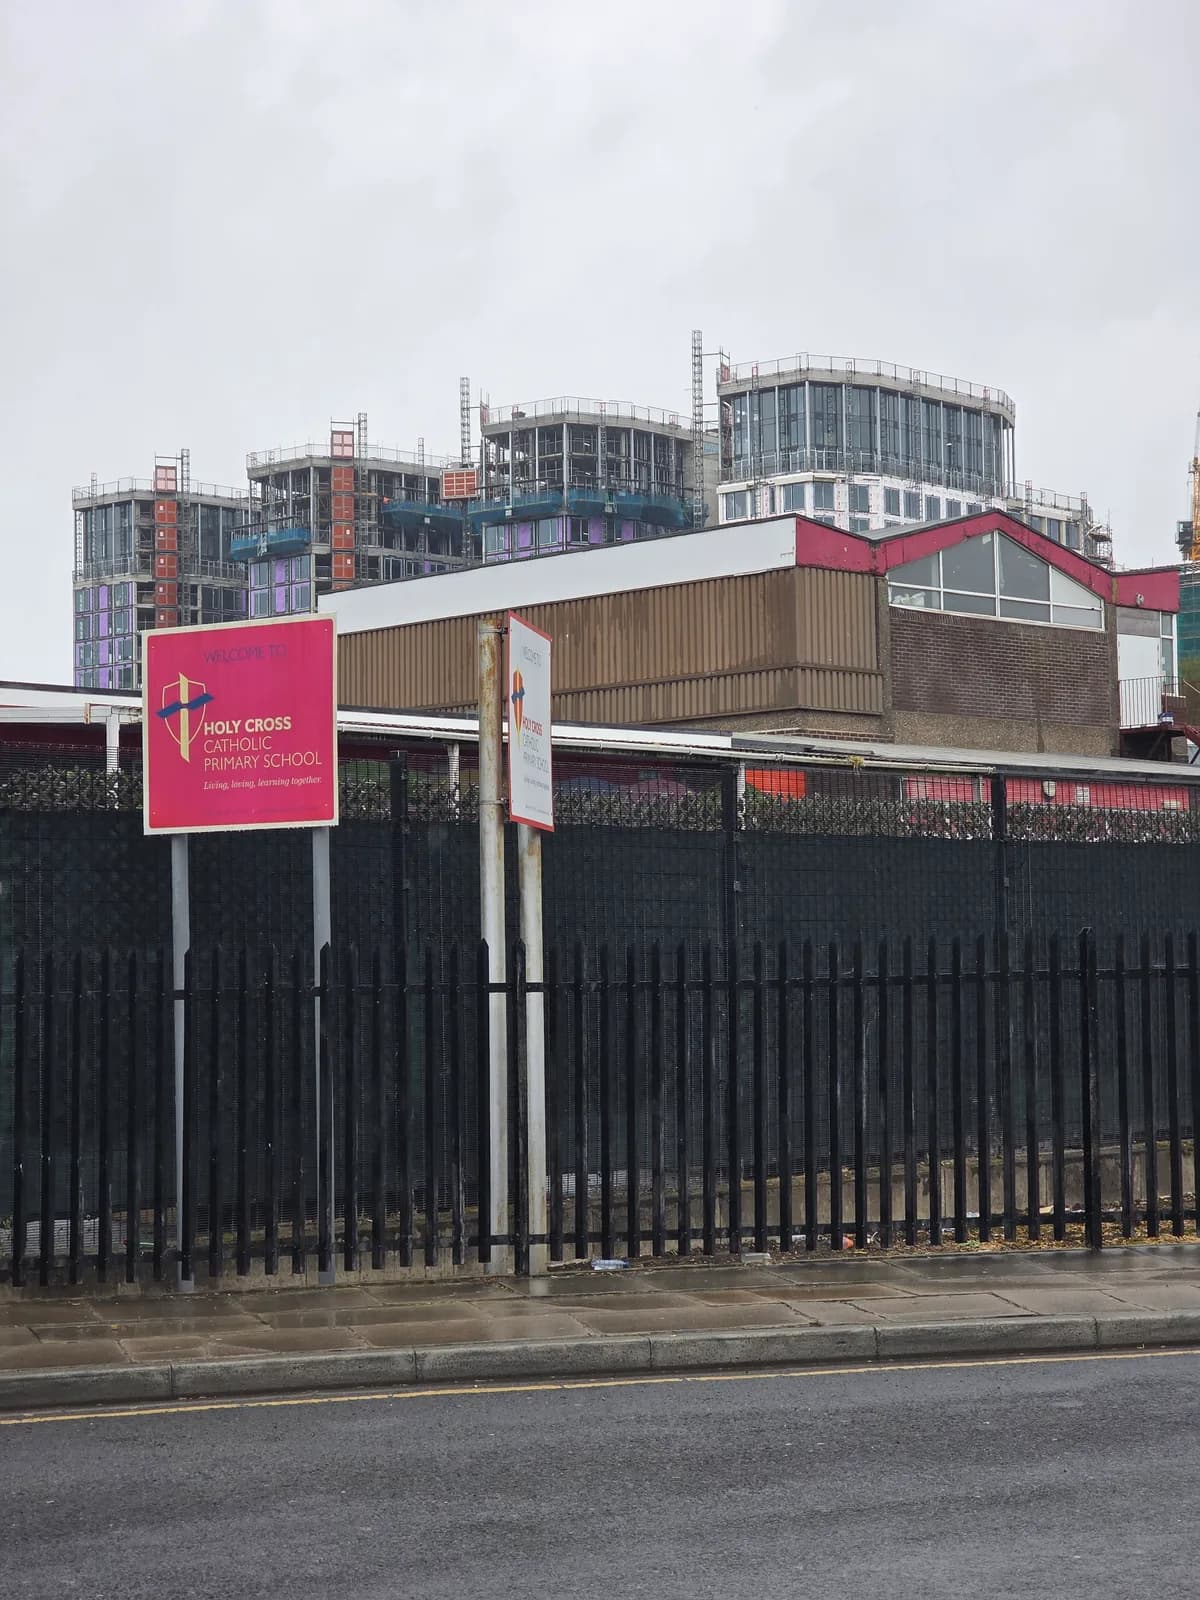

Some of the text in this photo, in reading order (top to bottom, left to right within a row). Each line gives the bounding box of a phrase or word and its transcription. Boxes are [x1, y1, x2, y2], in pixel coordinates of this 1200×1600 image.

[203, 644, 287, 663] WELCOME TO
[204, 716, 292, 736] HOLY CROSS
[203, 736, 272, 754] CATHOLIC
[204, 751, 323, 773] PRIMARY SCHOOL
[203, 775, 322, 791] Living, loving, learning together.
